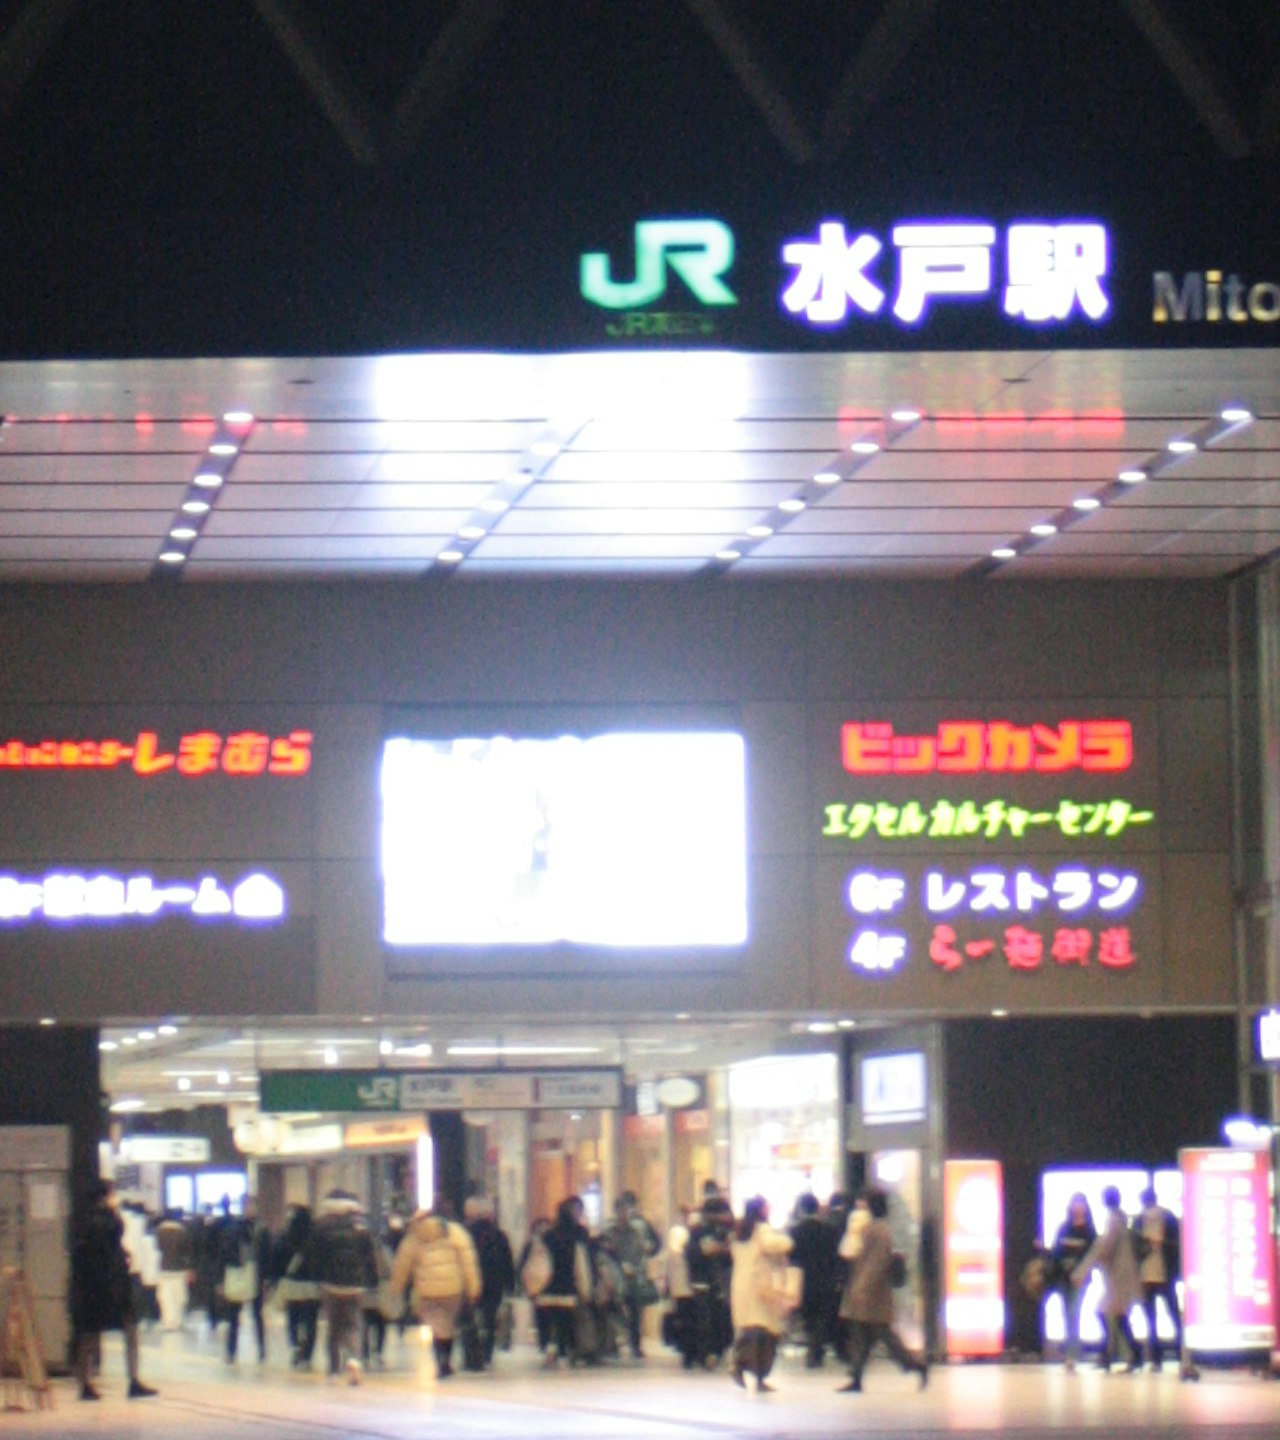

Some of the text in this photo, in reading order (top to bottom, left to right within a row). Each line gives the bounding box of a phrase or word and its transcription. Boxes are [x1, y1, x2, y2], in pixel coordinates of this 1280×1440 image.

[580, 219, 1108, 321] JR 水戸駅
[842, 720, 1132, 776] ビックカメラ
[926, 871, 1138, 912] レストラン
[851, 931, 907, 969] 4F
